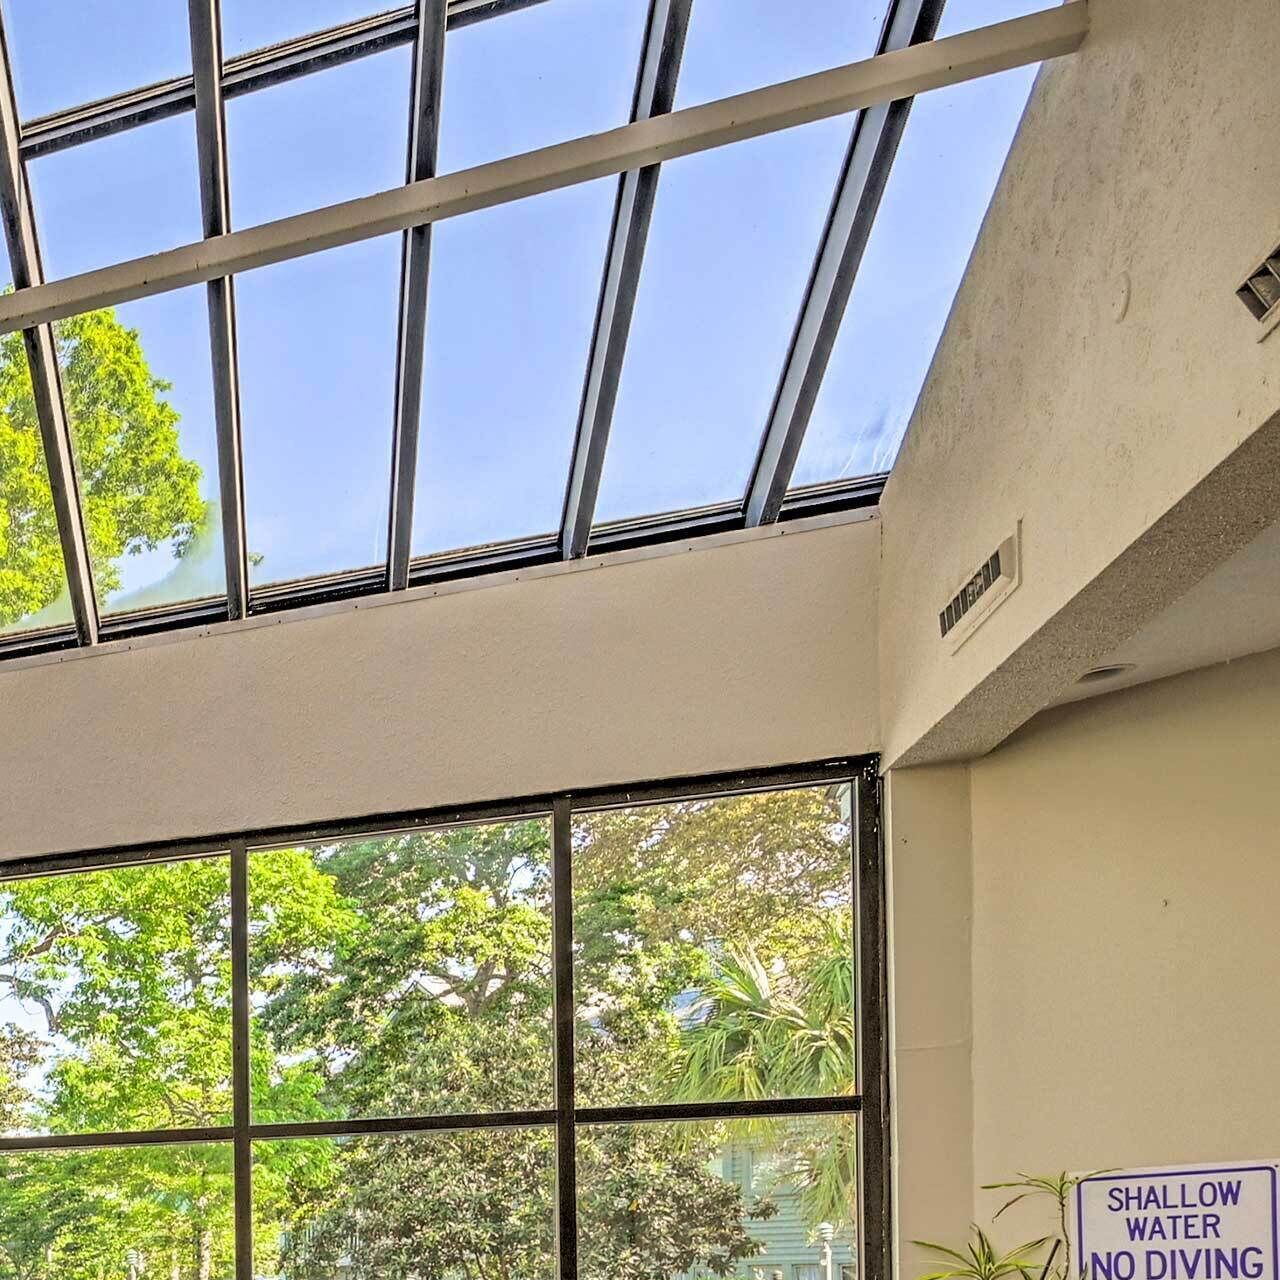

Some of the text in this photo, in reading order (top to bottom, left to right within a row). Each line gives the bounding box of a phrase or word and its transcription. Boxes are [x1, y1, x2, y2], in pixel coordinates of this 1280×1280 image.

[1107, 1180, 1242, 1212] SHALLOW
[1126, 1213, 1221, 1241] WATER
[1091, 1247, 1264, 1280] NO DIVING
